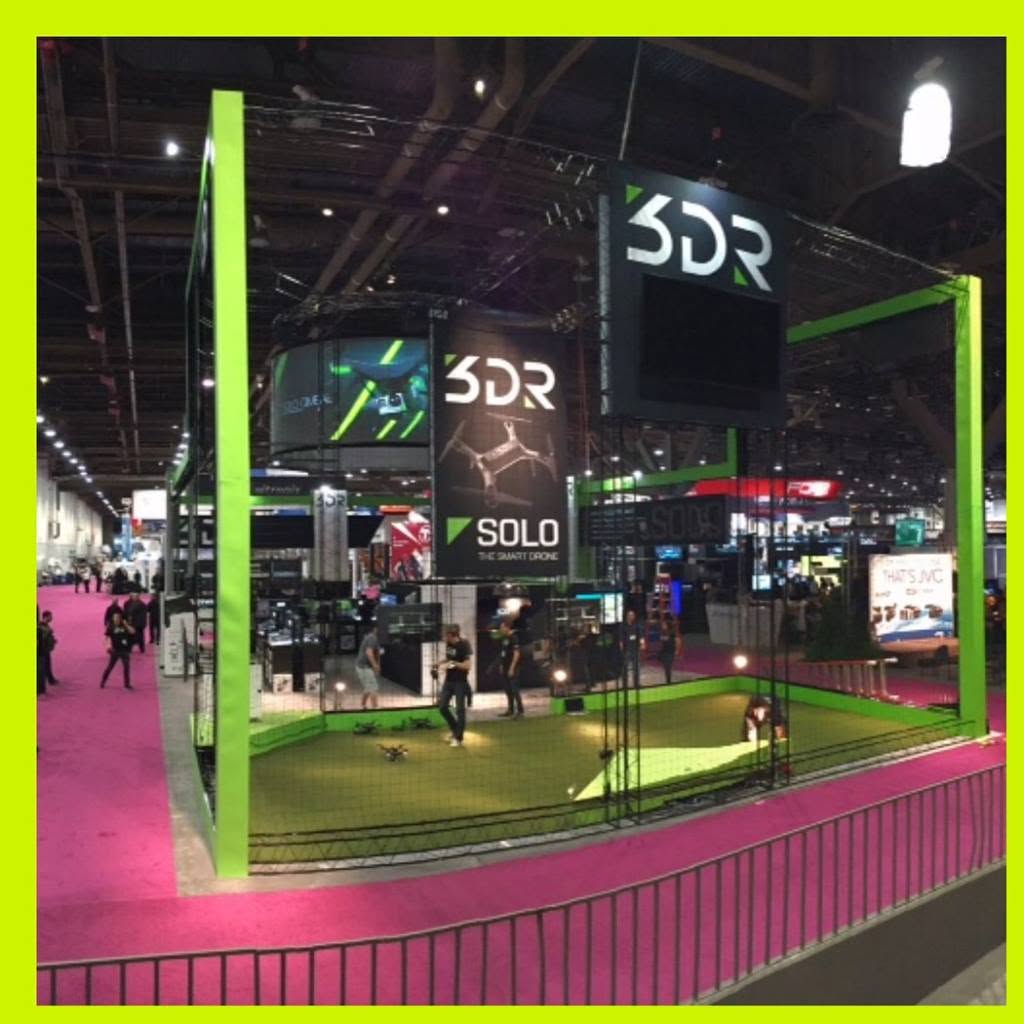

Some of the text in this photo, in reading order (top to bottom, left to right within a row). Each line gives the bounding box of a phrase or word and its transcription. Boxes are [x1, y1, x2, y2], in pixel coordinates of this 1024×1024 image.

[626, 185, 773, 292] 3DR
[444, 354, 556, 410] 3DR
[477, 518, 560, 548] SOLO
[497, 551, 527, 561] SMART
[529, 551, 559, 561] DRONE
